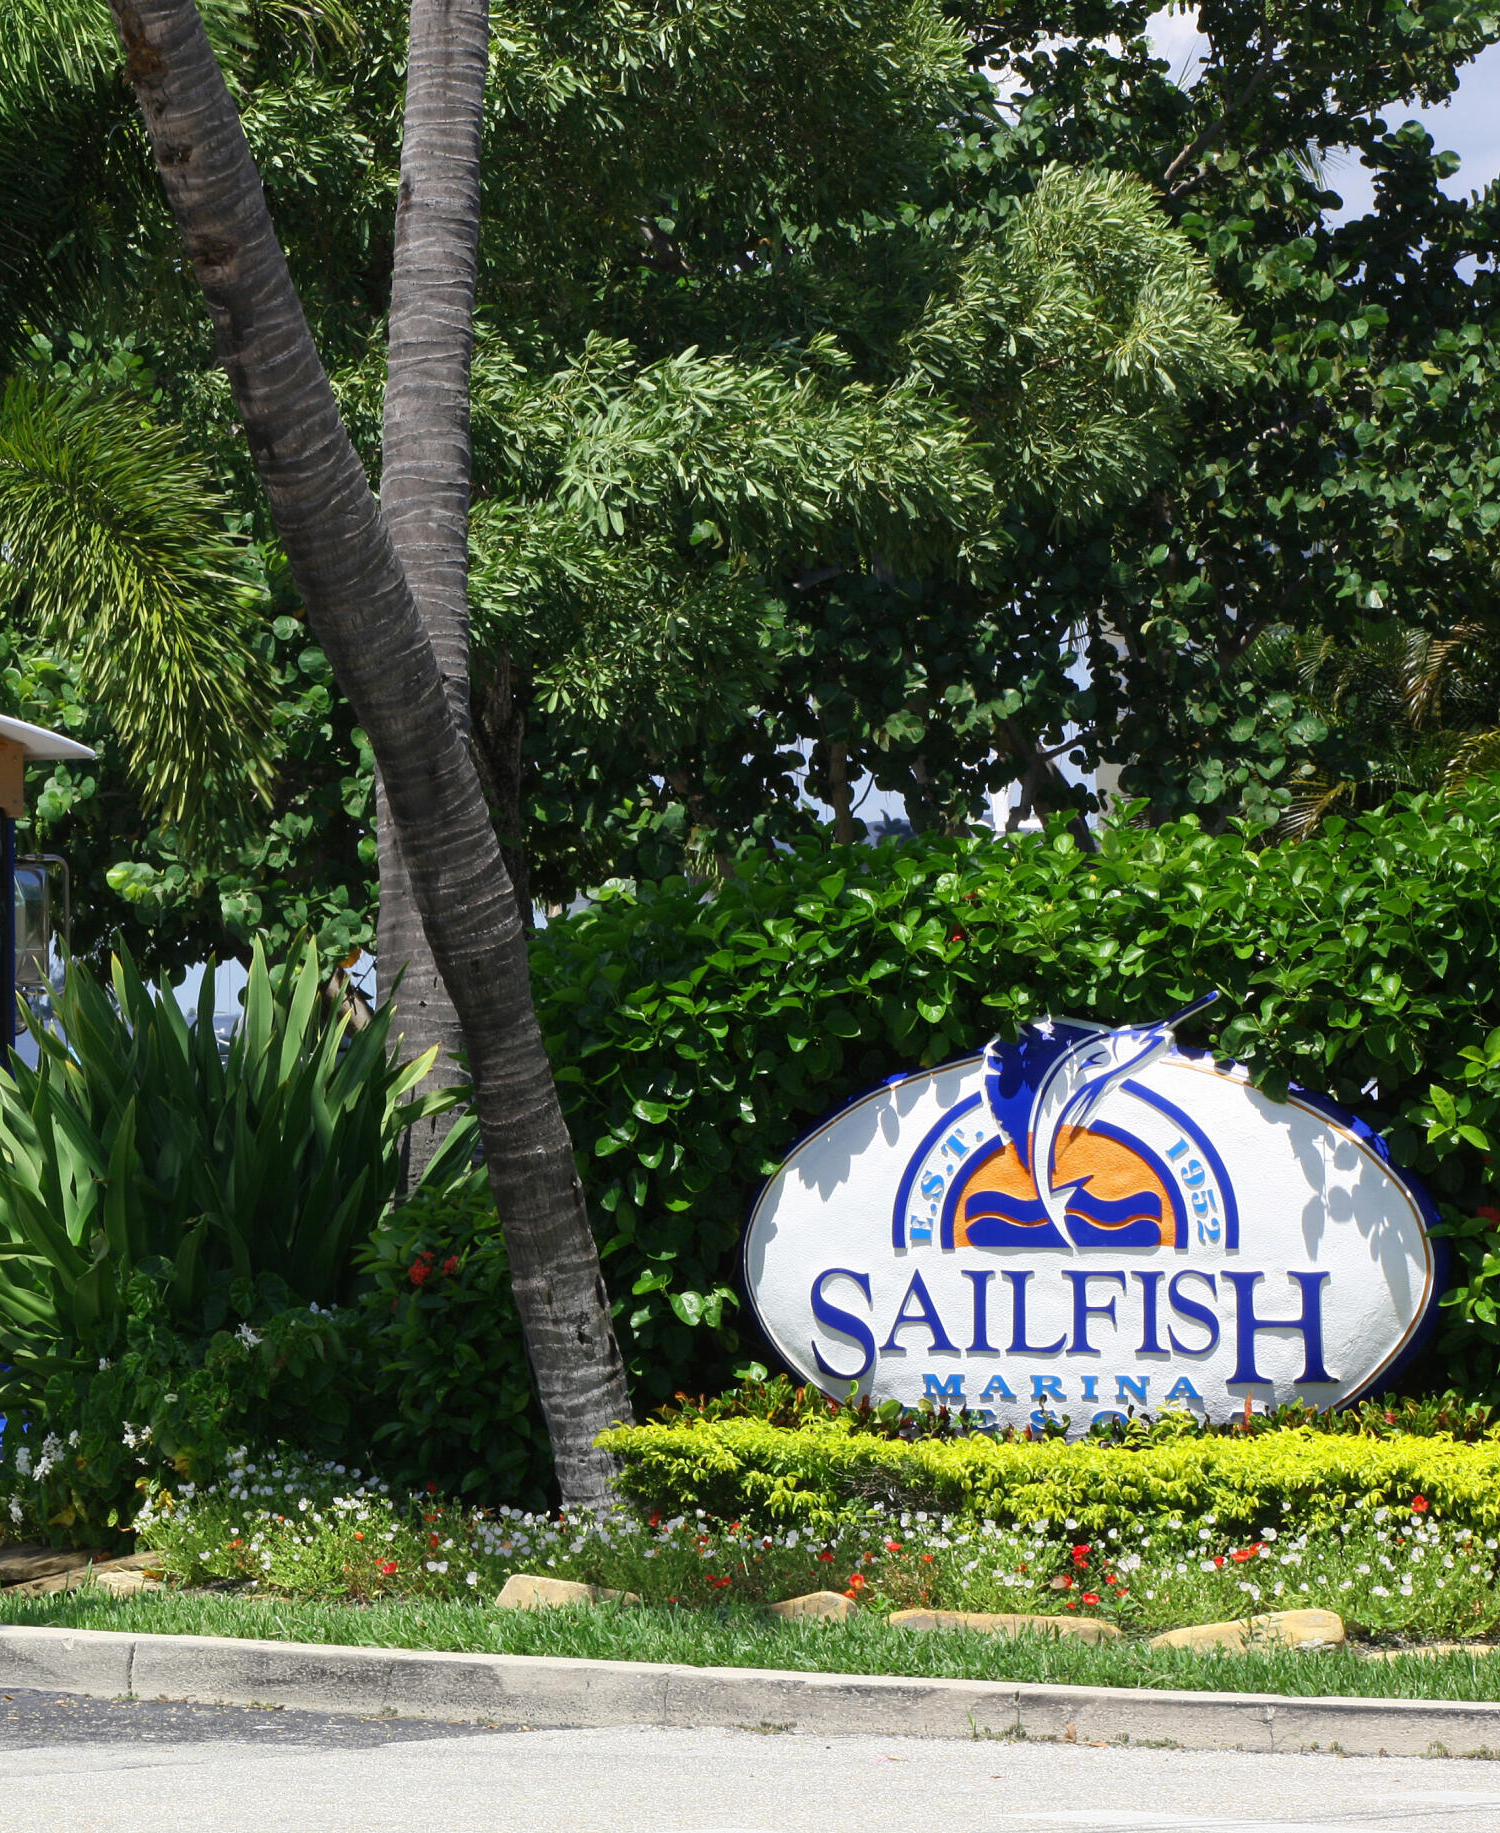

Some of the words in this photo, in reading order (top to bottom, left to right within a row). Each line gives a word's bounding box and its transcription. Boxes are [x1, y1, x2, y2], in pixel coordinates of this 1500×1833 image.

[1165, 1137, 1221, 1246] 1952
[810, 1267, 1339, 1385] SAILFISH
[922, 1373, 1202, 1400] MARINA
